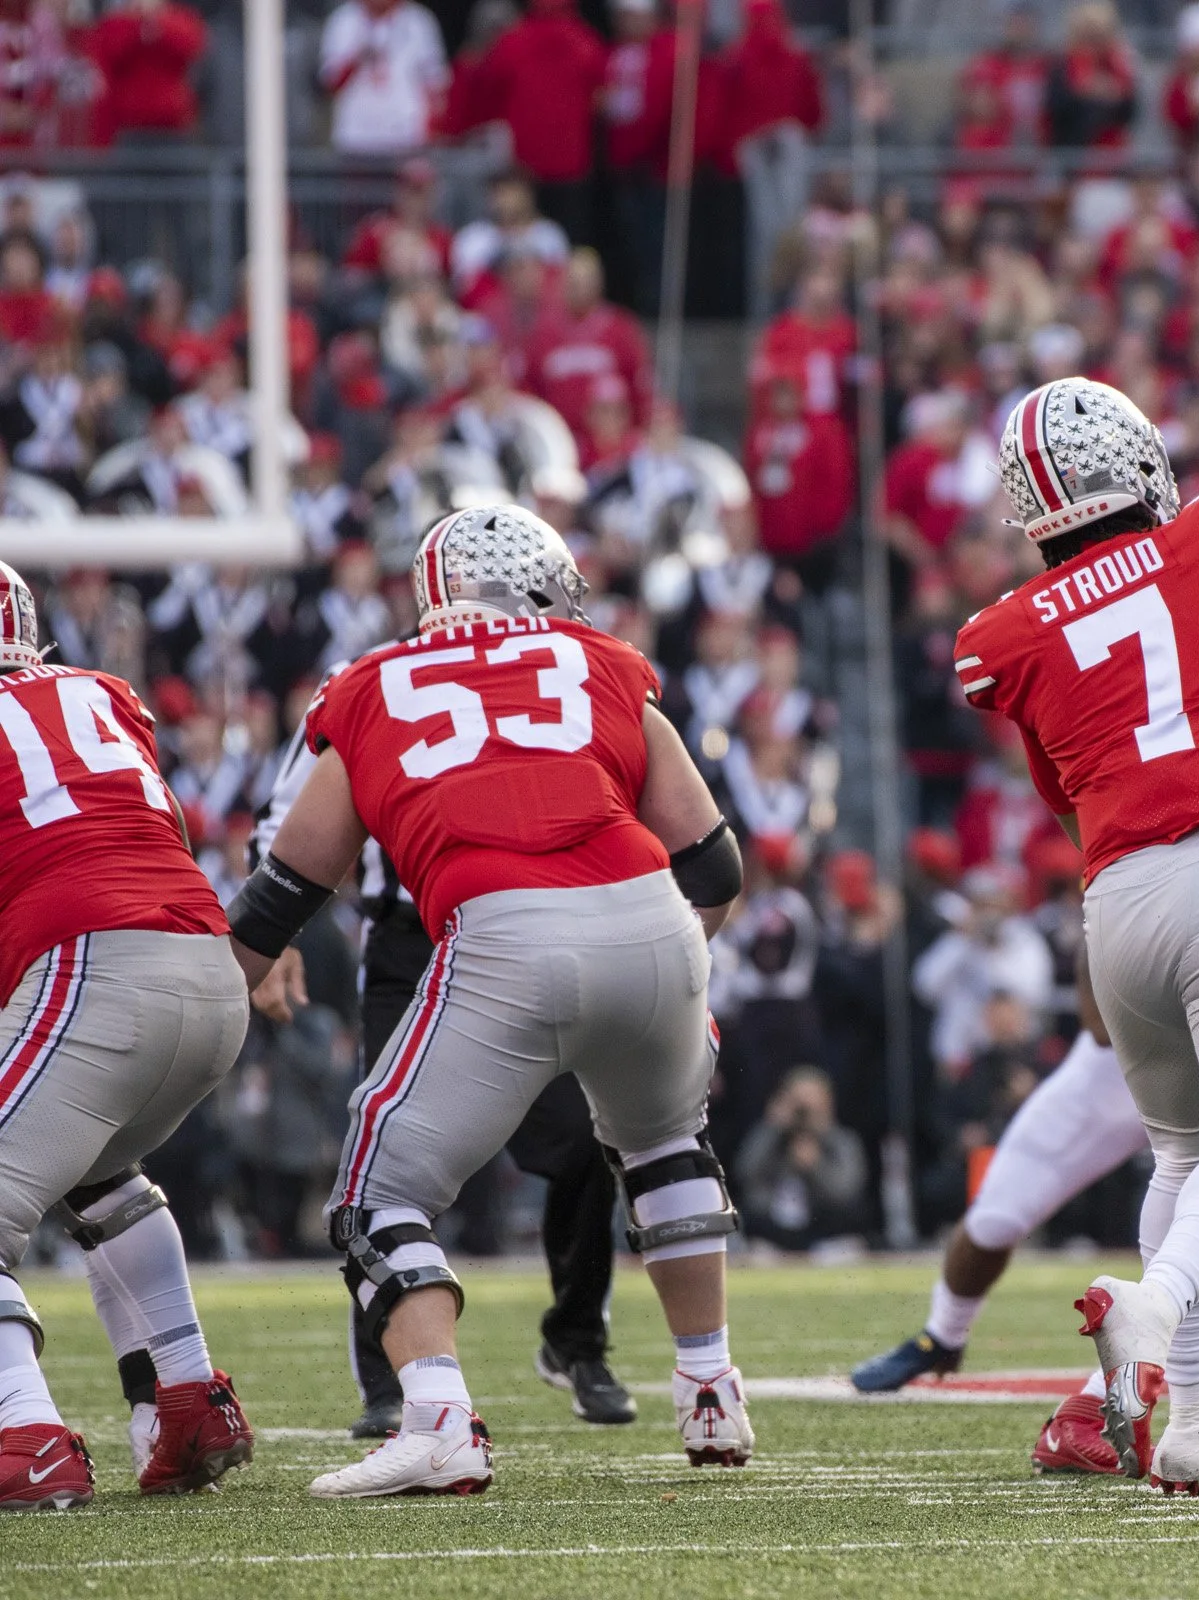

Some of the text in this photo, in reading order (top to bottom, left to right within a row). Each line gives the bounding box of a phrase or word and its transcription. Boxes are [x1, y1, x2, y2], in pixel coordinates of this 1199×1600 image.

[1069, 479, 1078, 489] 7
[1028, 502, 1109, 539] BUCKEYES
[450, 584, 461, 594] 53
[1032, 537, 1164, 623] STROUD
[1062, 583, 1195, 762] 7
[380, 632, 592, 779] 53
